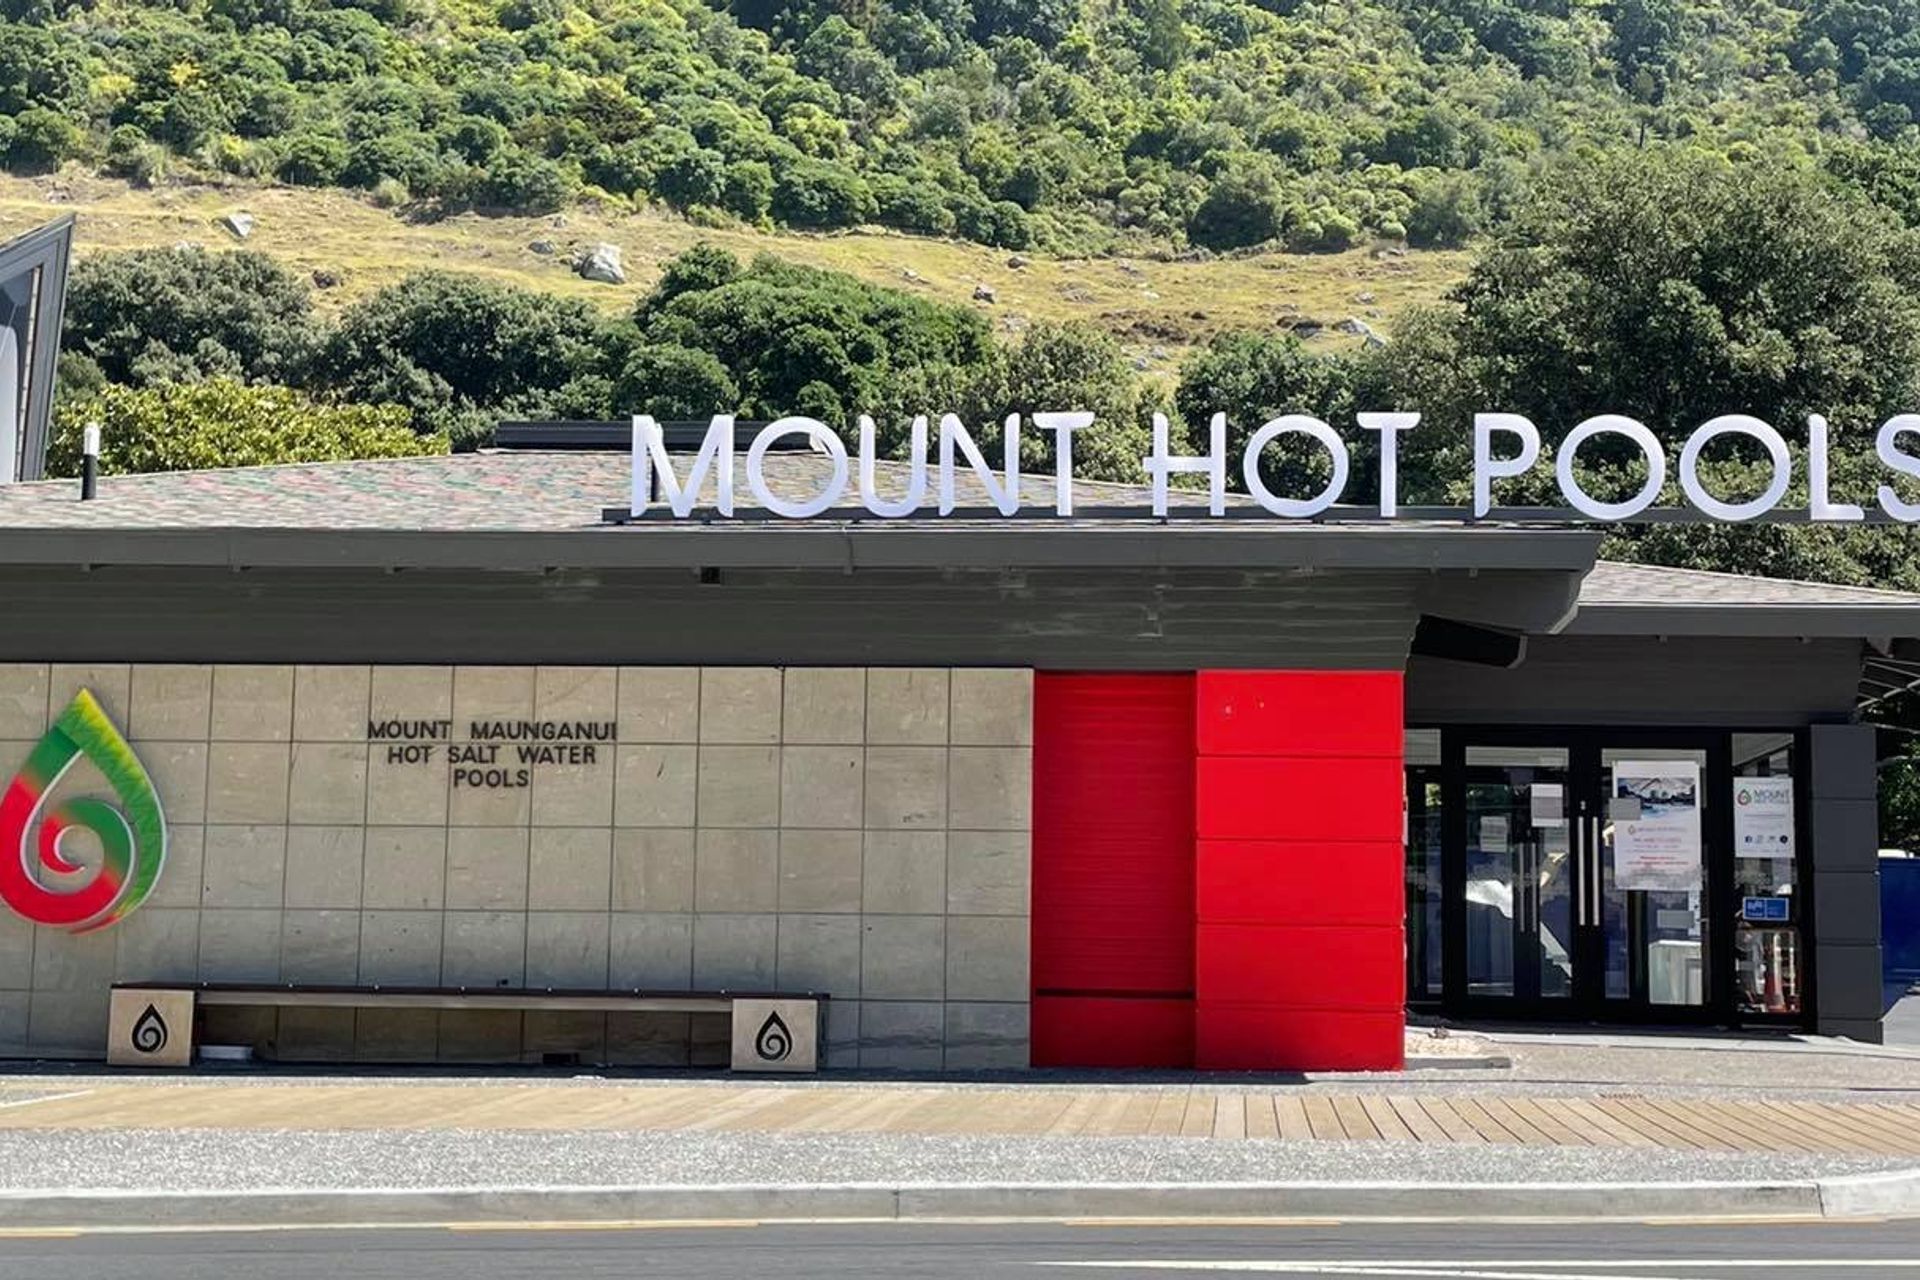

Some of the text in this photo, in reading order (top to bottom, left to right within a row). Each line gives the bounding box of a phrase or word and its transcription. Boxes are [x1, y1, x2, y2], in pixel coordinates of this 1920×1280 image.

[631, 412, 1920, 520] MOUNT HOT POOLS
[368, 720, 618, 740] MOUNT MAUNGANUI
[387, 746, 596, 764] HOT SALT WATER
[453, 769, 529, 788] POOLS
